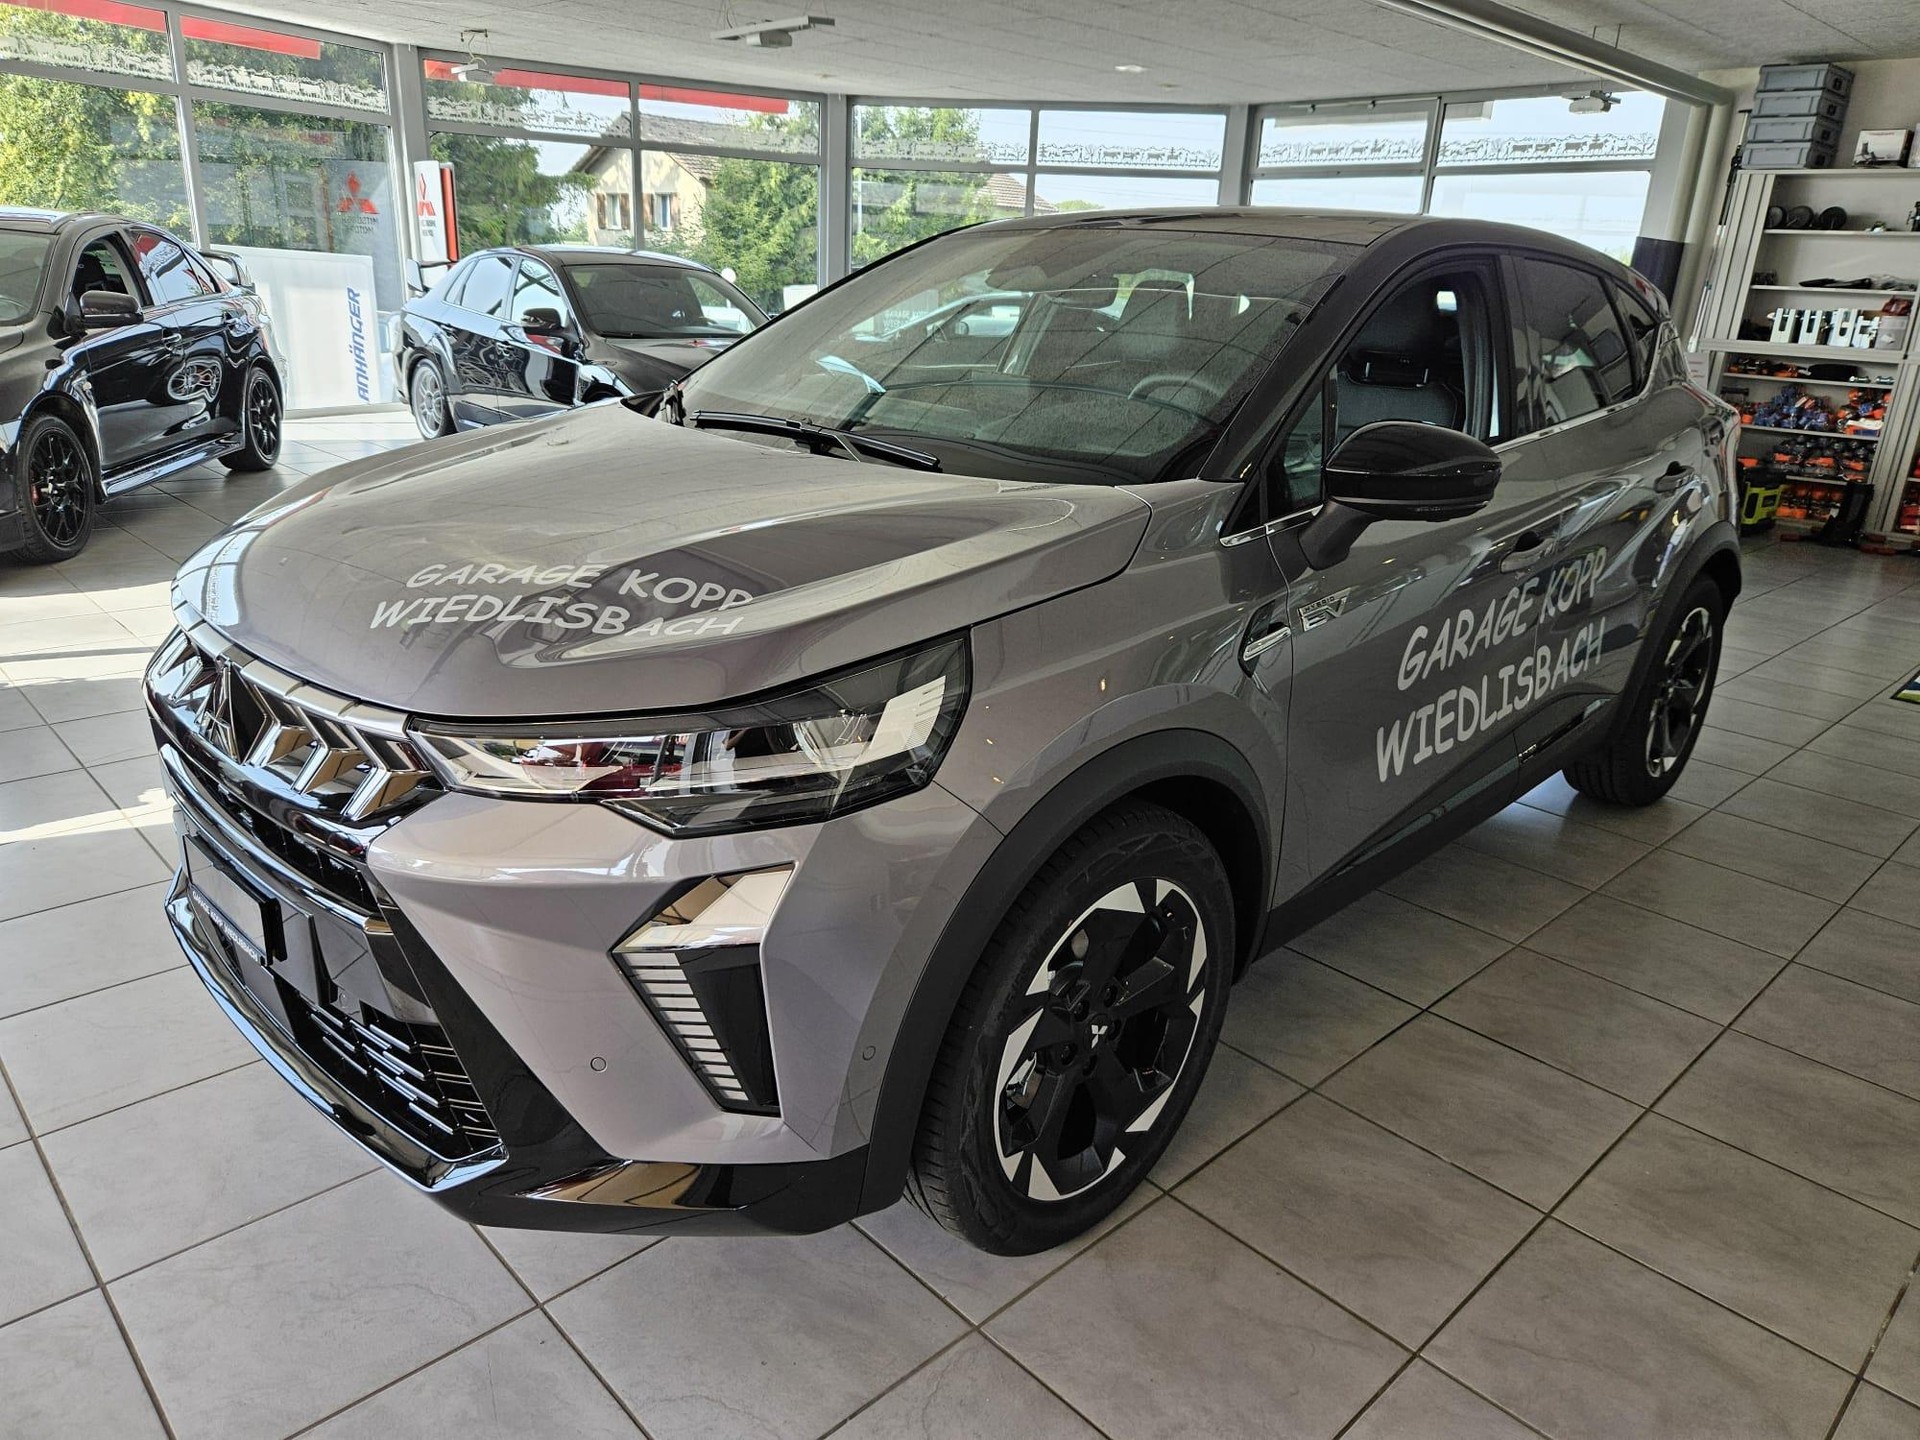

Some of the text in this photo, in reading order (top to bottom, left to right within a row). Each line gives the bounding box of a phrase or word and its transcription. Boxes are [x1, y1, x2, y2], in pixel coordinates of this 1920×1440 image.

[346, 287, 370, 404] ANHÄNGER
[370, 594, 744, 636] WIEDLISBACH
[406, 563, 753, 612] GARAGE KOPP
[1301, 596, 1349, 632] EV
[1397, 547, 1608, 691] GARAGE KOPP
[1376, 616, 1606, 782] WIEDLISBACH
